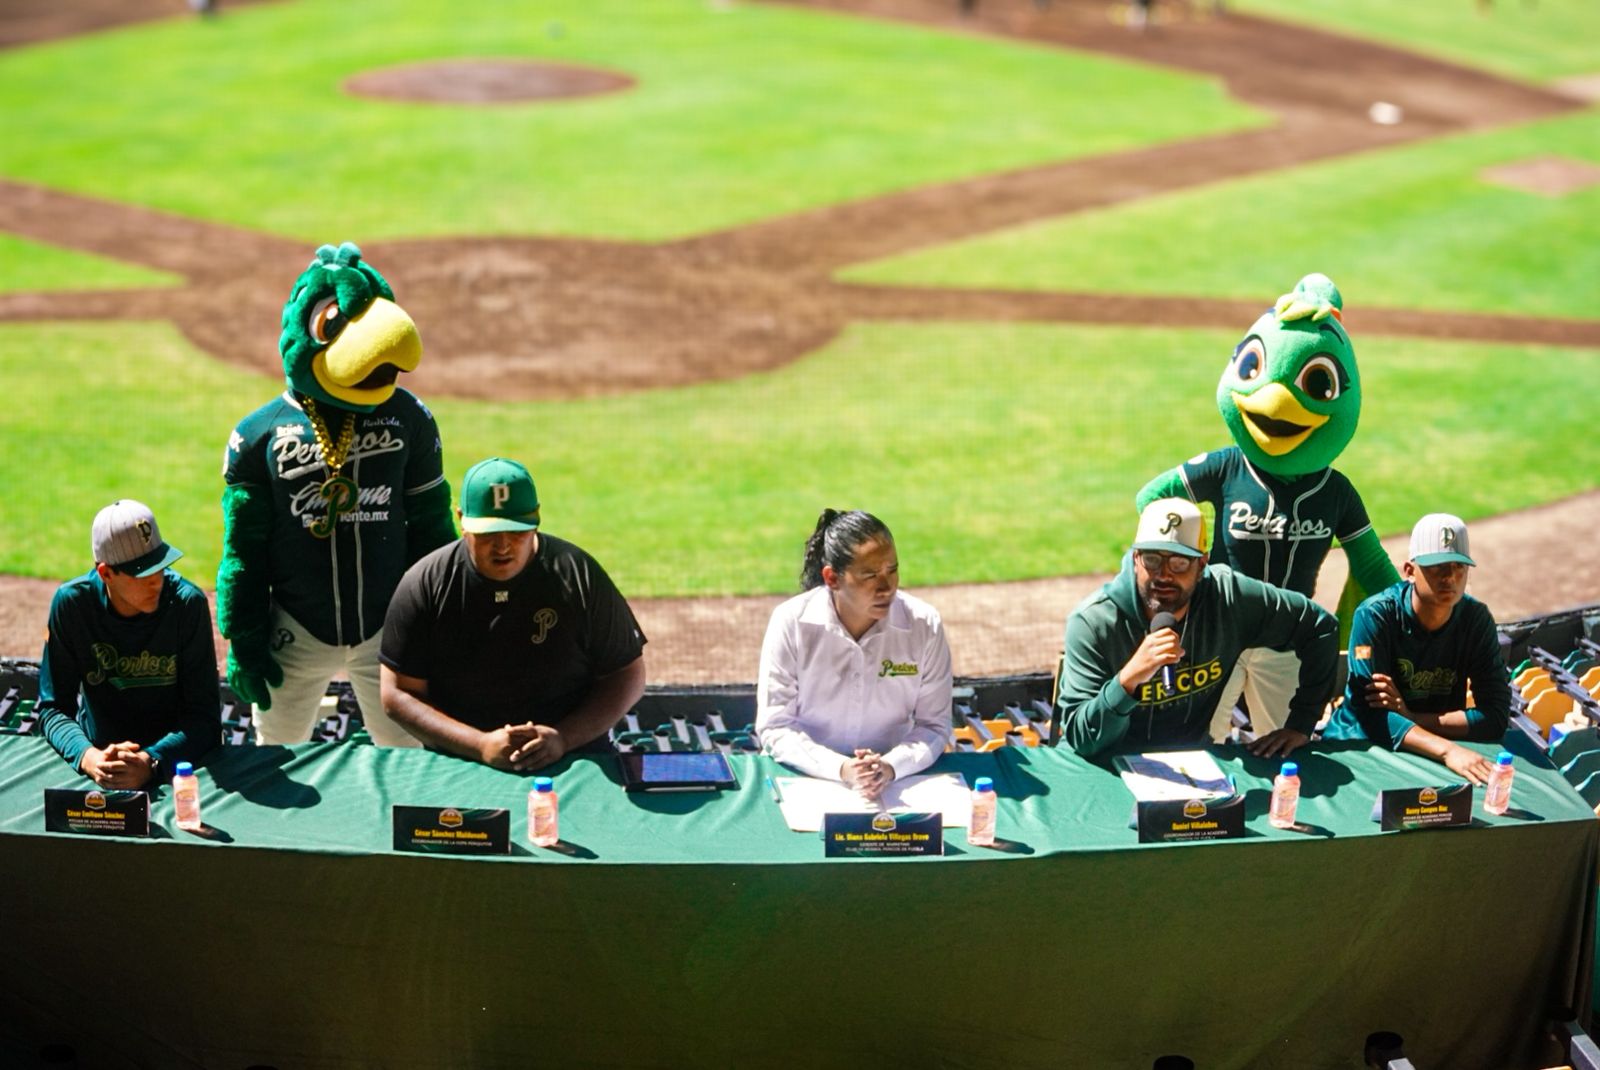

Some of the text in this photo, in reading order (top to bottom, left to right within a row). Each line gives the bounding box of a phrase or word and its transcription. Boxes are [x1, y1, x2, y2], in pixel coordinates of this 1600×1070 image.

[490, 482, 510, 510] P
[136, 519, 153, 545] P
[1160, 512, 1182, 535] P
[1441, 526, 1456, 548] P
